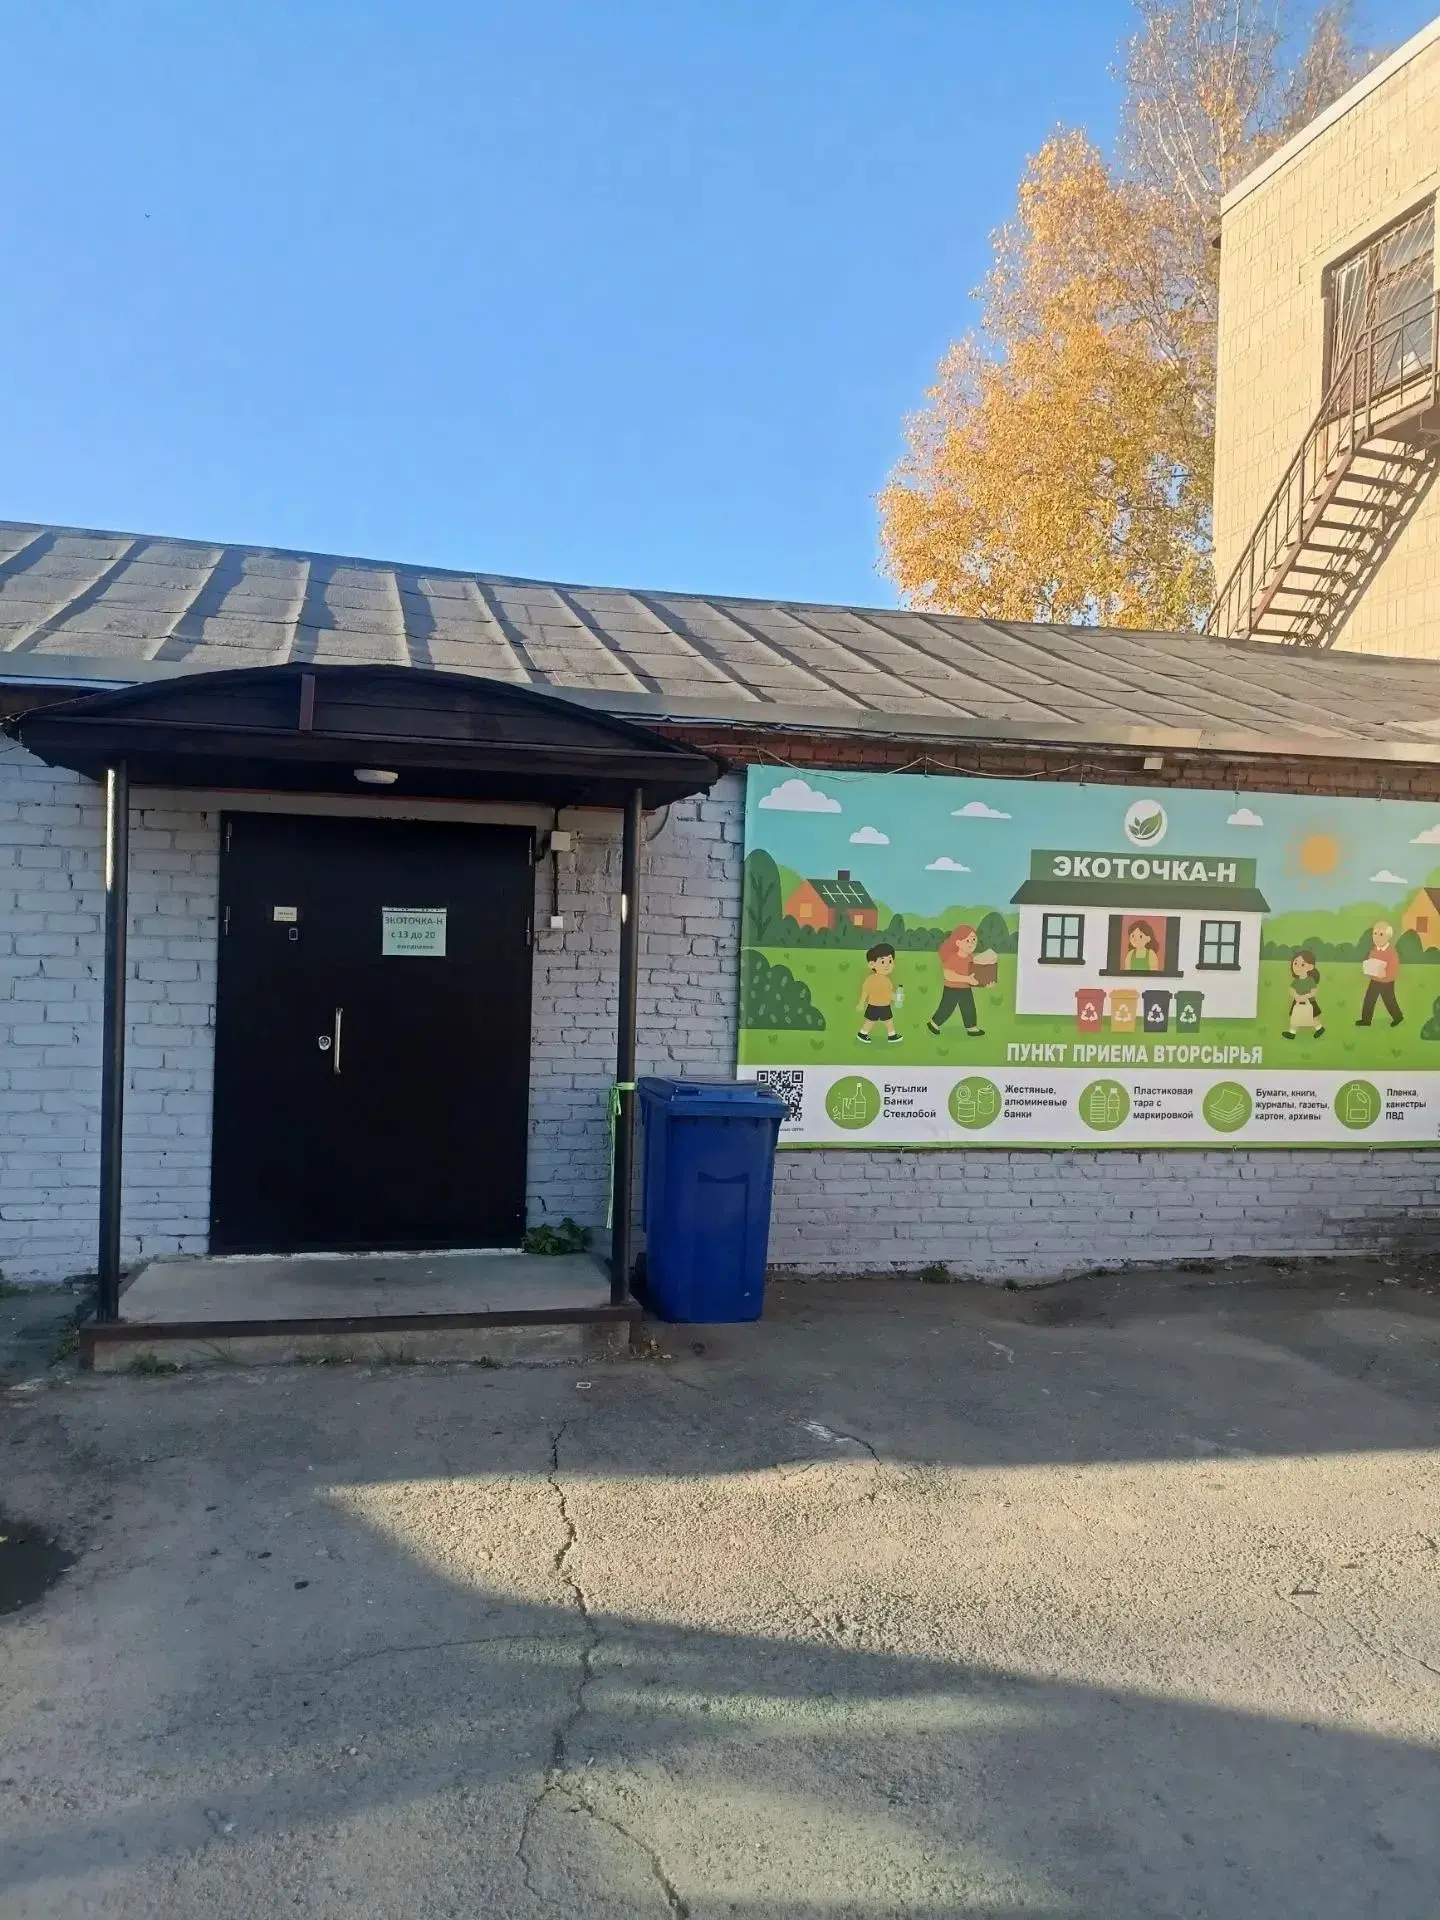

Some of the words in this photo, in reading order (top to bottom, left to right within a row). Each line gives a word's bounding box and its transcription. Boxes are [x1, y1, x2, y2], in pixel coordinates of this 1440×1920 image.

[1052, 855, 1237, 883] ЭКОТОЧКА-Н
[384, 917, 443, 925] ЭКОТОЧКА-Н
[399, 930, 408, 938] 13
[411, 932, 422, 940] до
[424, 931, 436, 939] 20
[1006, 1042, 1068, 1062] ПУНКТ
[1072, 1044, 1148, 1063] ПРИЕМА
[1153, 1045, 1263, 1064] ВТОРСЫРЬЯ
[884, 1084, 928, 1095] Бутылки
[1005, 1084, 1057, 1095] Жестяные,
[1133, 1086, 1193, 1096] Пластиковая
[1256, 1088, 1289, 1098] Бумаги,
[1291, 1090, 1317, 1098] книги,
[1386, 1088, 1419, 1097] Пленка,
[883, 1097, 914, 1106] Банки
[1004, 1098, 1068, 1107] алюминевые
[1133, 1100, 1154, 1108] тара
[1255, 1101, 1297, 1110] журналы,
[1299, 1101, 1330, 1110] газеты,
[1386, 1101, 1427, 1110] канистры
[883, 1109, 936, 1119] Стеклобой
[1003, 1109, 1032, 1118] банки
[1133, 1110, 1194, 1120] маркировкой
[1255, 1113, 1287, 1121] картон,
[1288, 1113, 1321, 1121] архивы
[1385, 1111, 1405, 1120] ПВД
